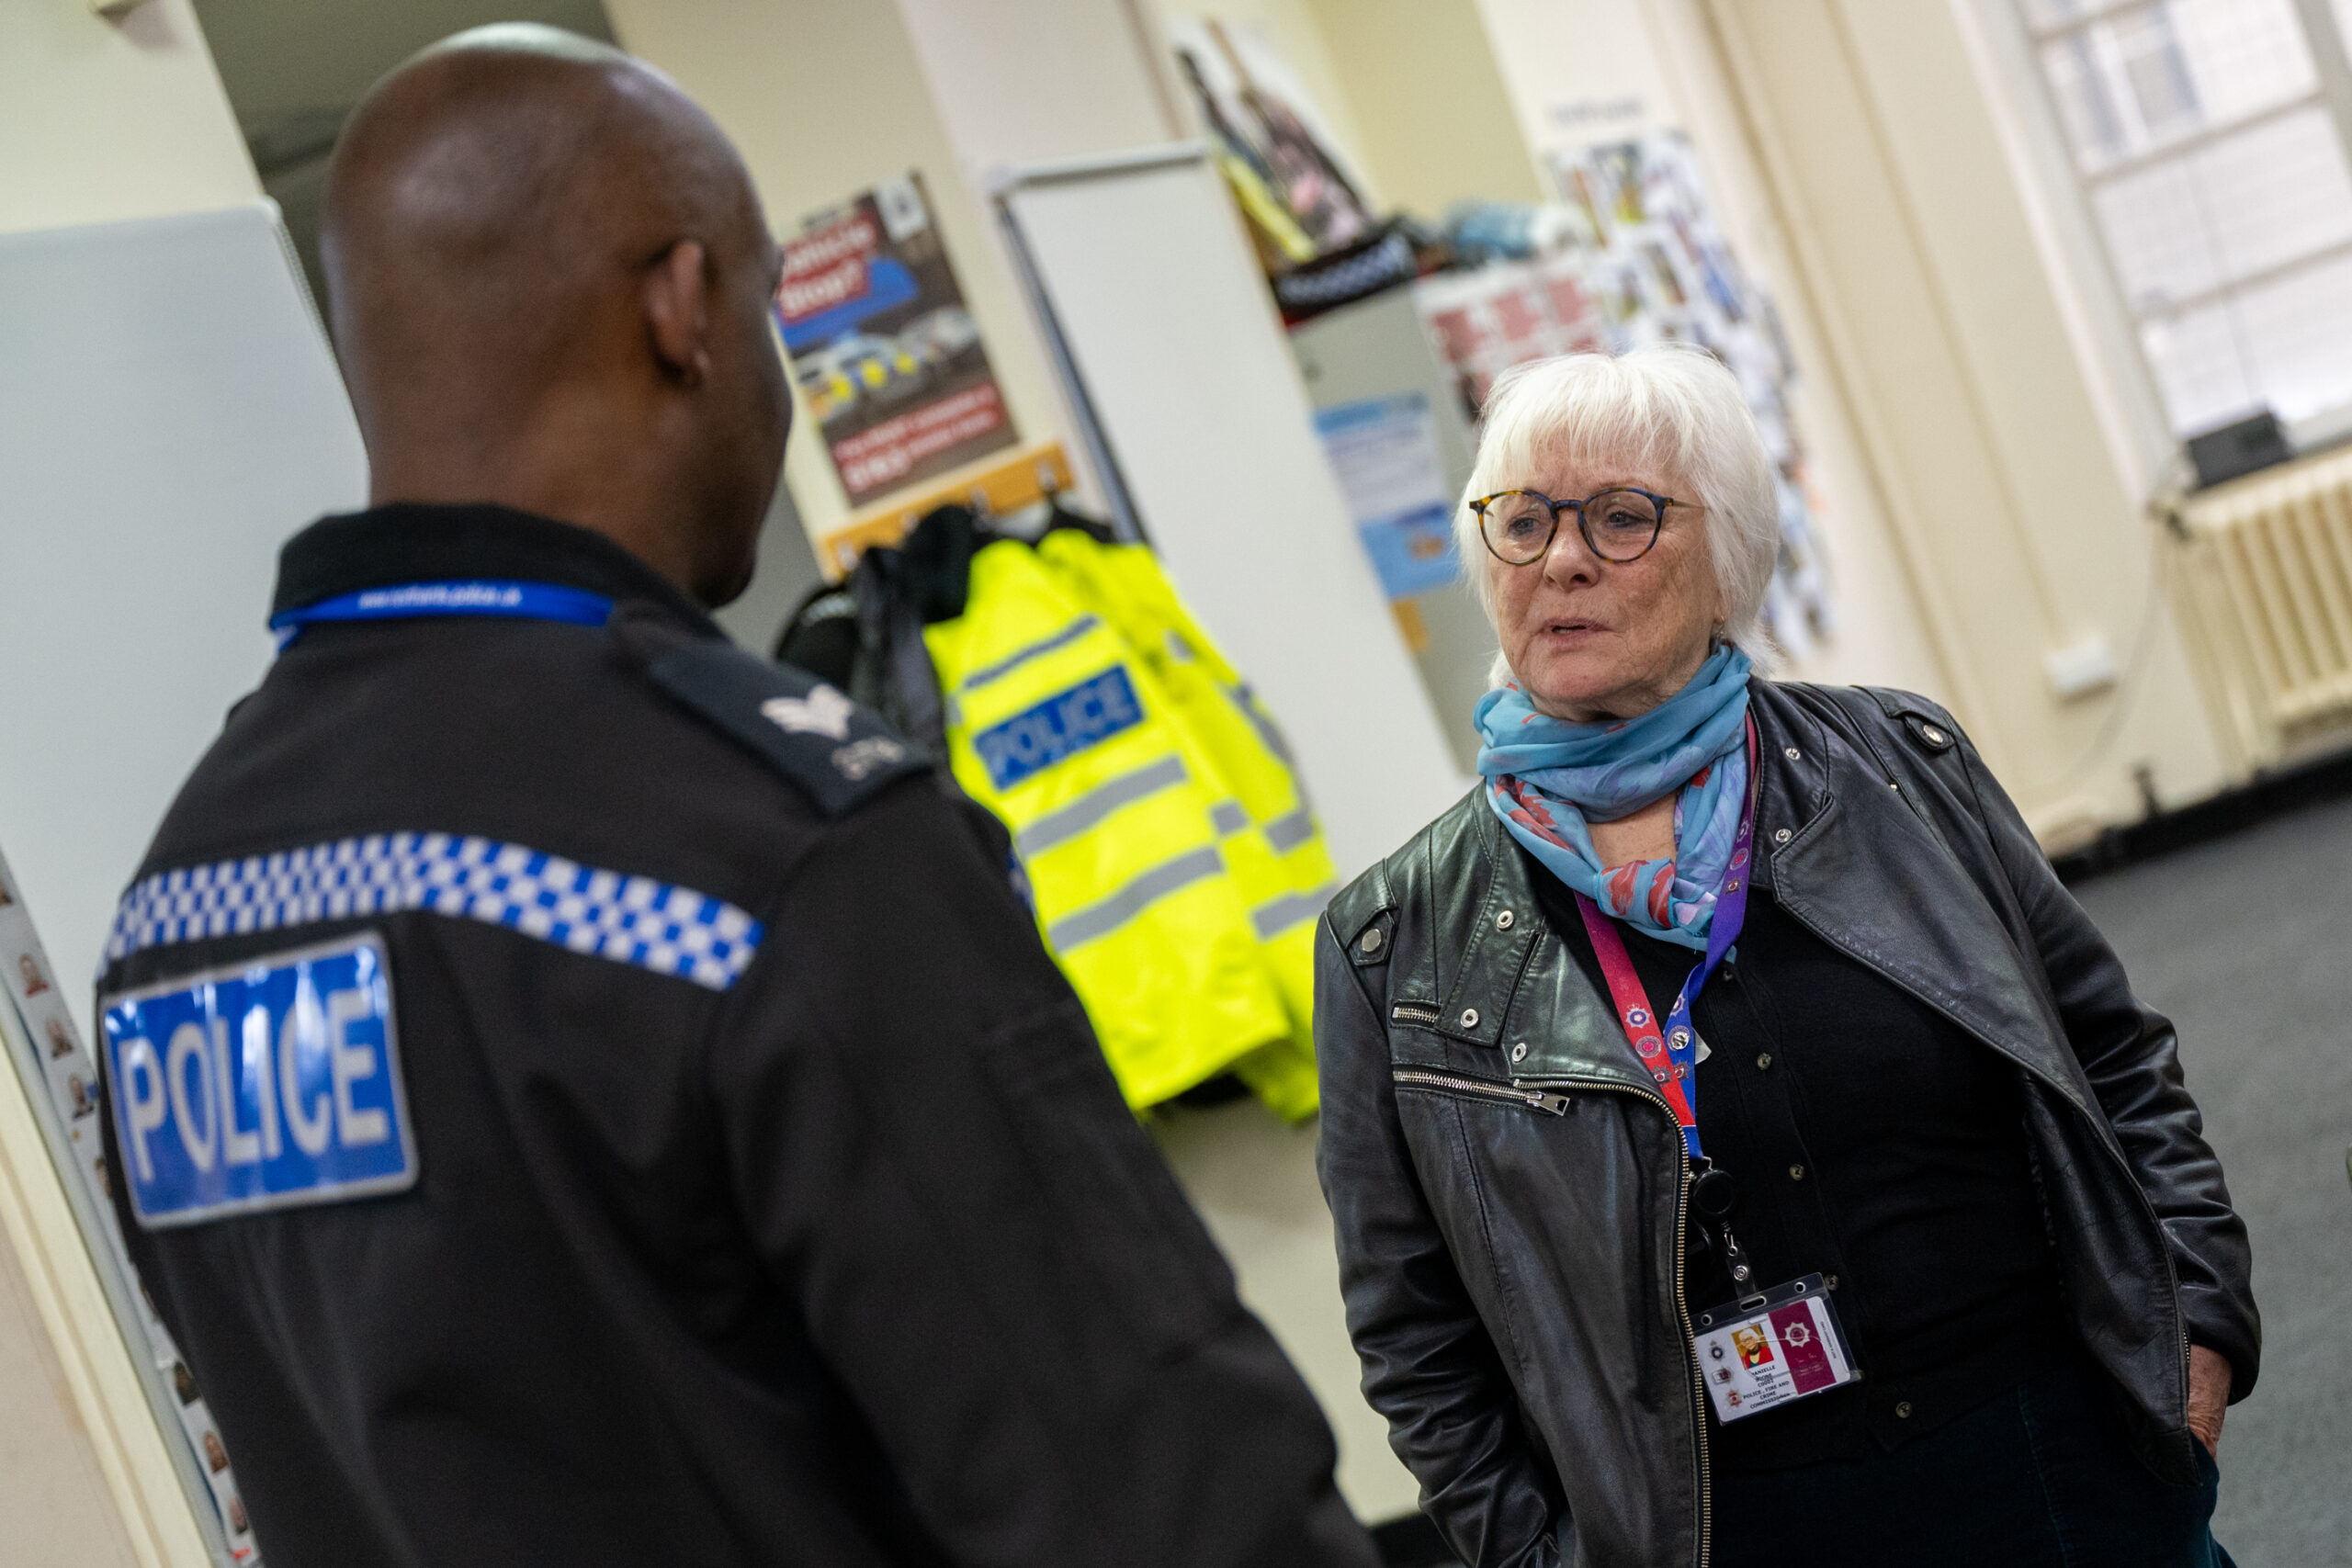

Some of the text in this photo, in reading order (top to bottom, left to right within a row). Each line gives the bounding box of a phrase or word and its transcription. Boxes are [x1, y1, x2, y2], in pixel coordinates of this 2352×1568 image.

[977, 671, 1136, 784] POLICE
[117, 988, 390, 1182] POLICE
[1759, 1391, 1776, 1400] CRIME
[1765, 1384, 1777, 1393] FIRE
